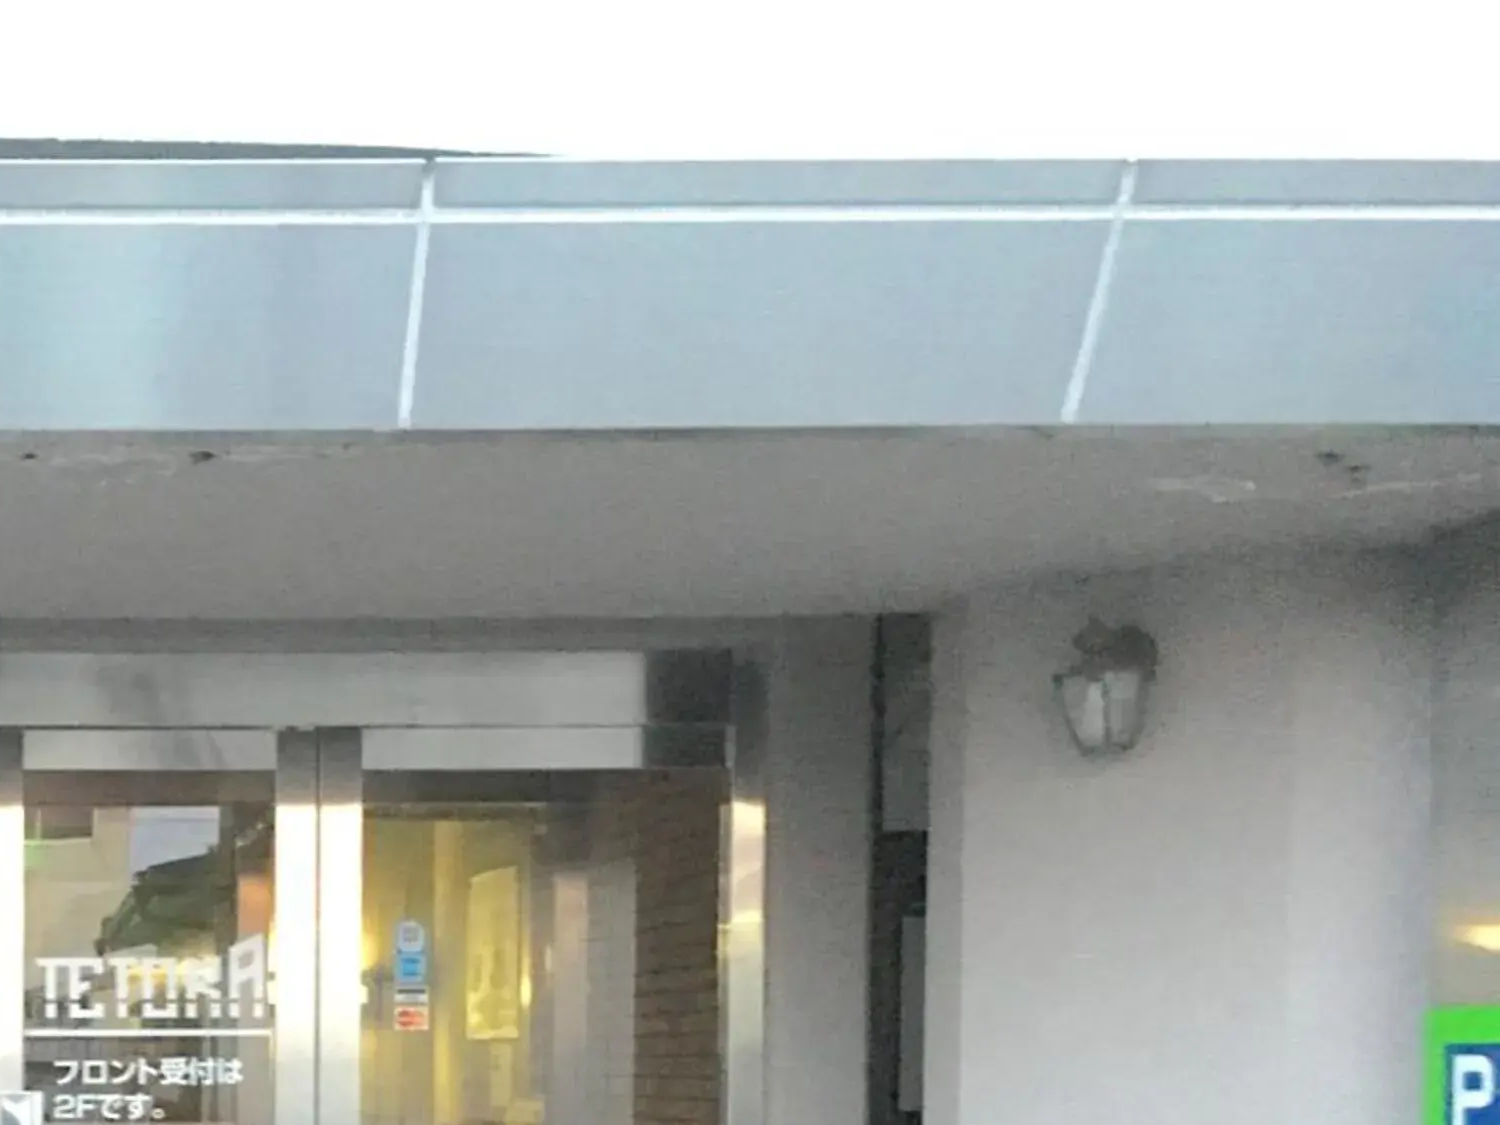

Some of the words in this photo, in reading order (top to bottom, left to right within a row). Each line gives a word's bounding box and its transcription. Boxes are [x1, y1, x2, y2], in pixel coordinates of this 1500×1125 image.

[34, 932, 265, 1019] TETORA
[53, 1056, 244, 1086] フロント受付は
[53, 1091, 166, 1120] 2Fです。
